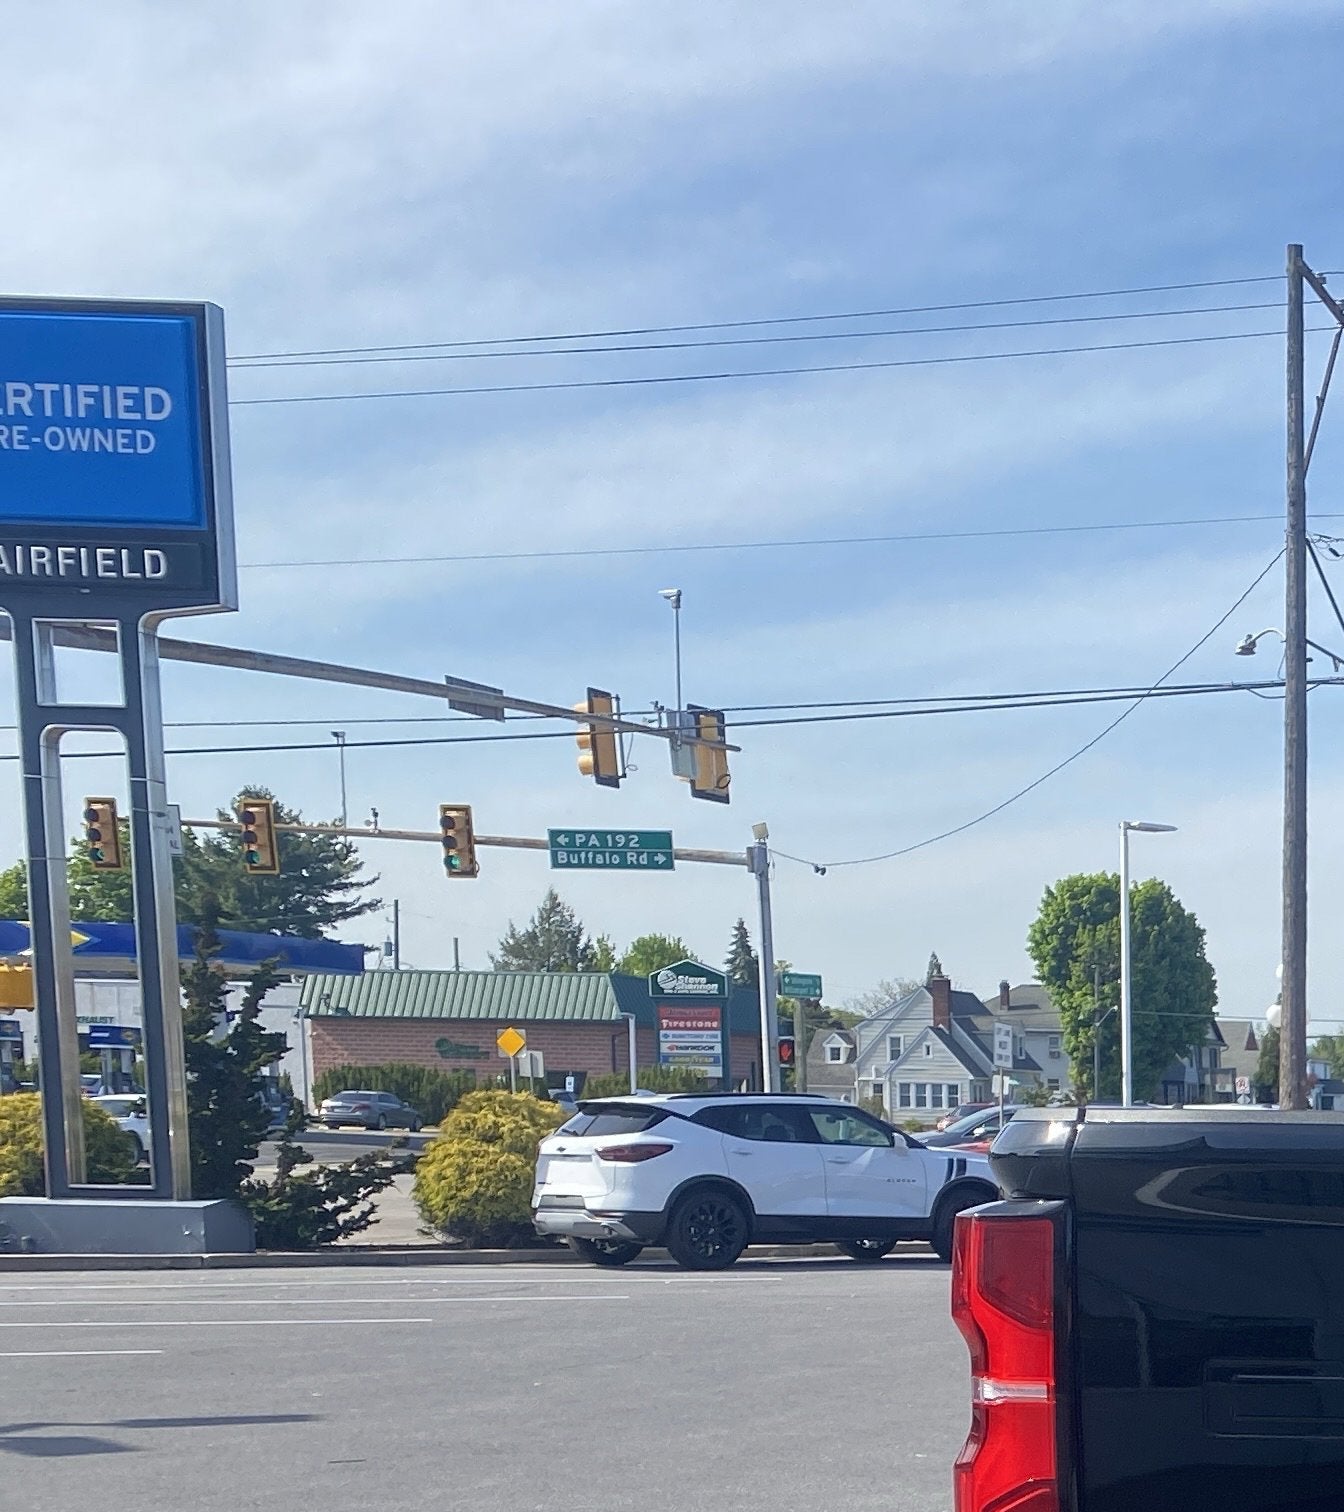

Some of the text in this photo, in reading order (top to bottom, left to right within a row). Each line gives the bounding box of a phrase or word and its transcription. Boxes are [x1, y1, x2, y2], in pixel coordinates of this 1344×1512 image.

[0, 382, 172, 421] RTIFIED
[575, 833, 640, 848] PA 192
[557, 851, 648, 865] Buffalo Rd
[661, 1019, 718, 1029] Firestone
